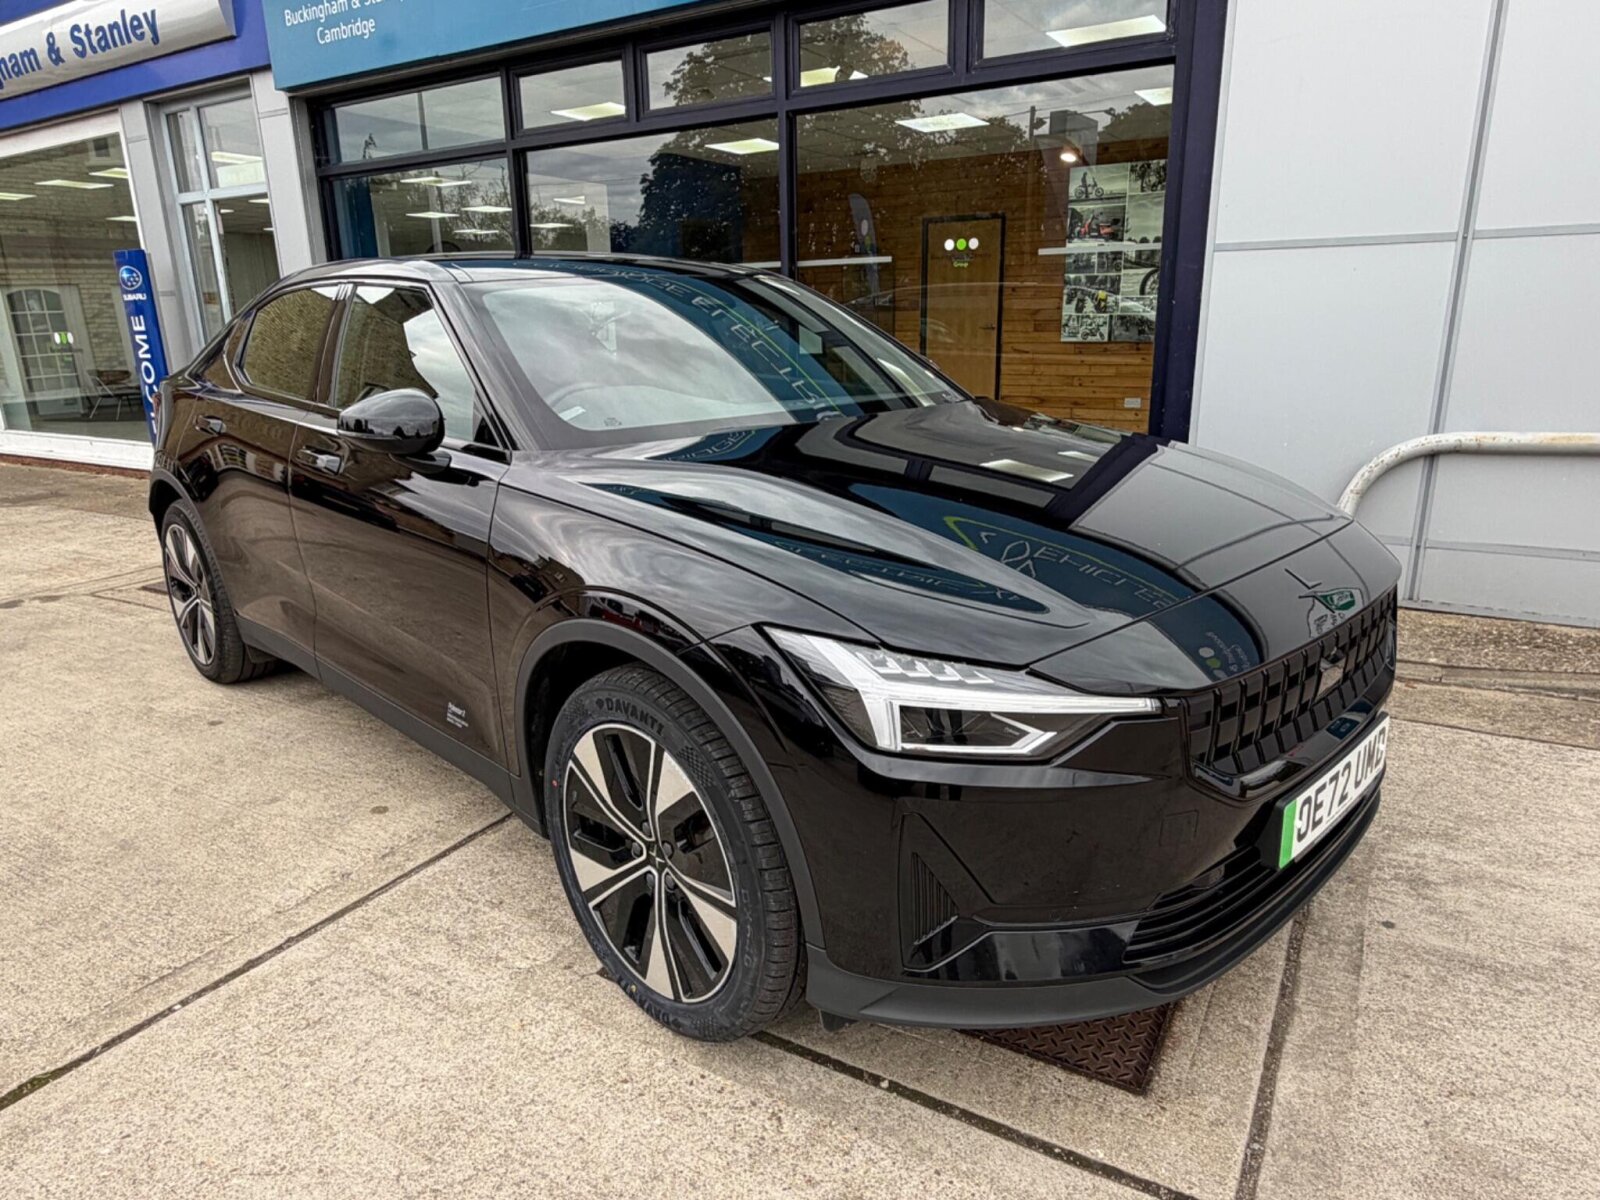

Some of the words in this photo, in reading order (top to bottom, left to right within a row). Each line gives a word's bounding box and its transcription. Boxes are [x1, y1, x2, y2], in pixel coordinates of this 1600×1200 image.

[284, 0, 349, 26] Buckingham
[316, 17, 376, 44] Cambridge
[0, 47, 42, 89] ham
[46, 31, 66, 66] &
[70, 8, 160, 59] Stanley
